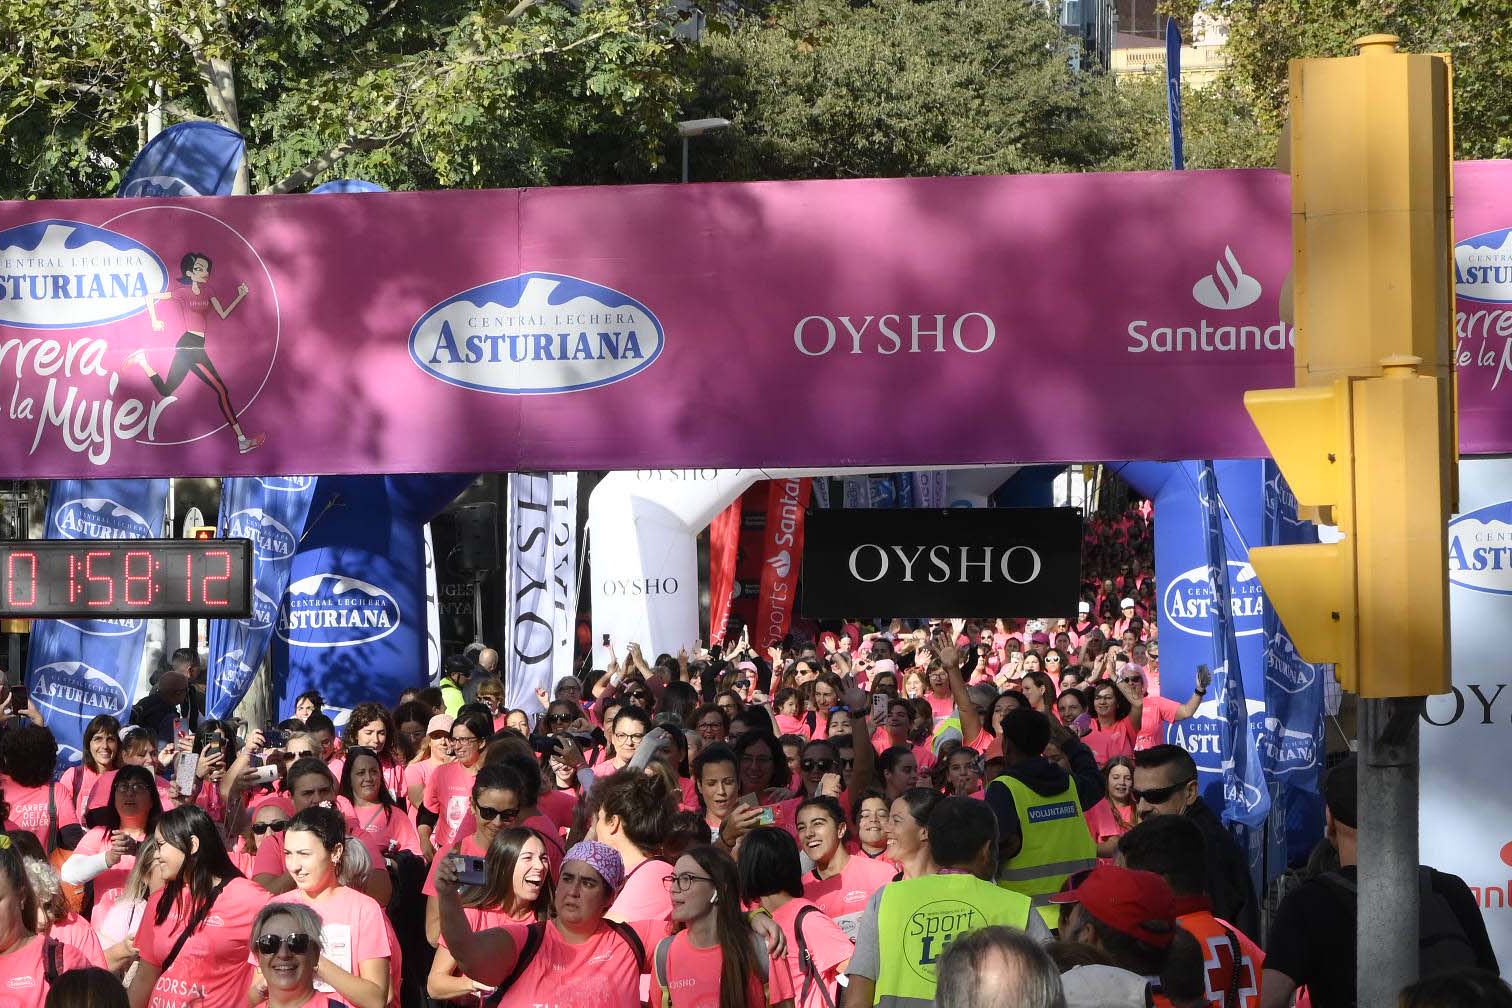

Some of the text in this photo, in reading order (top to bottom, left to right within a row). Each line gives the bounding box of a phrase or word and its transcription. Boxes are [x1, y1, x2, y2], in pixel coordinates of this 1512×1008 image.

[469, 312, 635, 328] CENTRAL LECHERA
[793, 312, 996, 356] OYSHO
[429, 320, 644, 363] ASTURIANA
[9, 381, 34, 420] la
[29, 372, 178, 466] Mujer
[775, 478, 801, 547] Santa
[848, 543, 1041, 584] OYSHO
[603, 577, 679, 596] OYSHO
[279, 603, 391, 630] ASTURIANA
[291, 600, 333, 608] CENTRAL
[34, 674, 118, 711] ASTURIANA
[22, 819, 49, 827] MUJER
[1029, 804, 1075, 819] VOLUNTARIS
[911, 909, 976, 938] Sport
[156, 977, 208, 997] DORSAL
